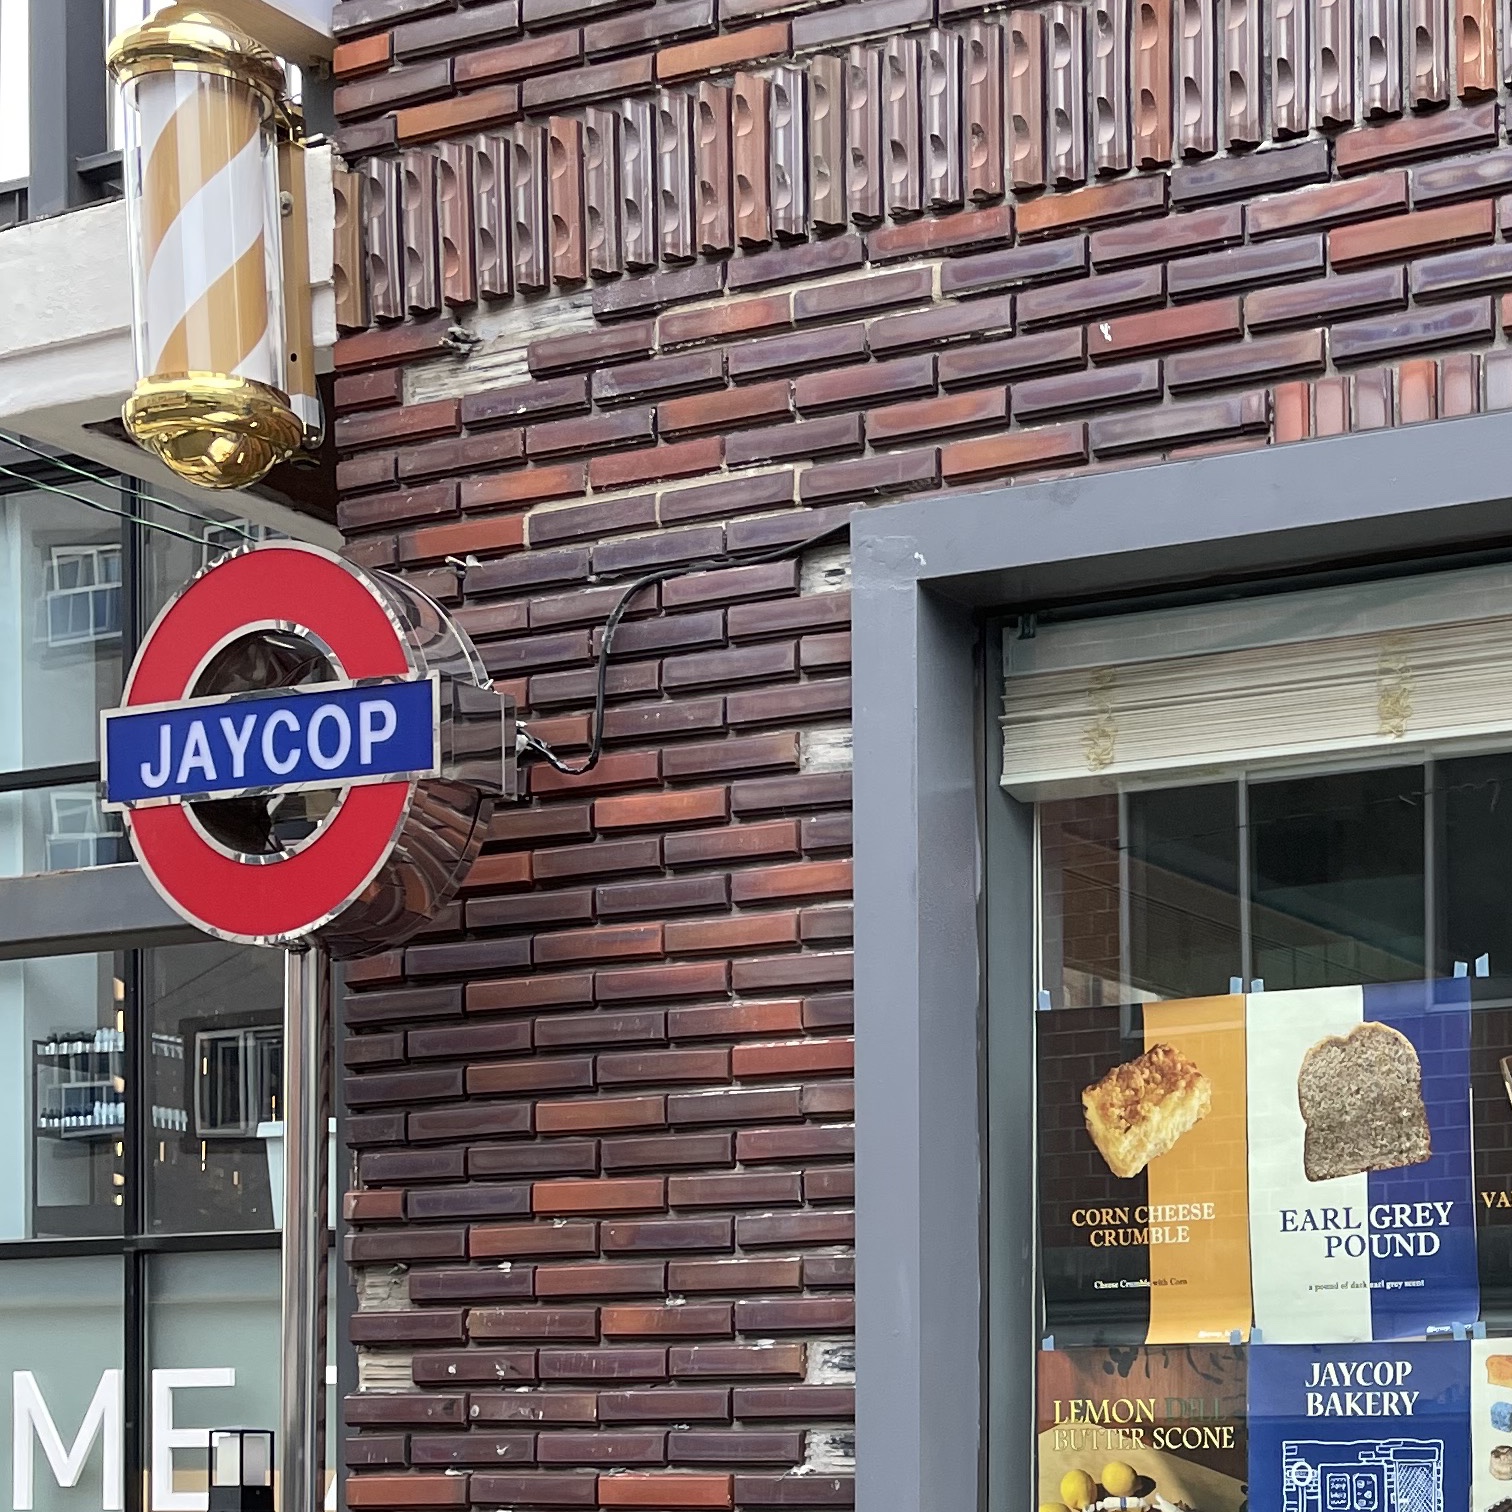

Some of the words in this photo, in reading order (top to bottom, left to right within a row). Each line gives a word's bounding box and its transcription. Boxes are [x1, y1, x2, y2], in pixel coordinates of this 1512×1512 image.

[140, 699, 398, 790] JAYCOP
[1072, 1206, 1129, 1227] CORN
[1134, 1203, 1215, 1223] CHEESE
[1279, 1207, 1362, 1232] EARL
[1369, 1201, 1453, 1229] GREY
[1090, 1226, 1190, 1247] CRUMBLE
[1324, 1231, 1441, 1258] POUND
[1305, 1361, 1413, 1387] JAYCOP
[1053, 1399, 1156, 1424] LEMON
[1305, 1391, 1420, 1417] BAKERY
[1053, 1428, 1146, 1450] BUTTER
[1153, 1426, 1235, 1449] SCONE
